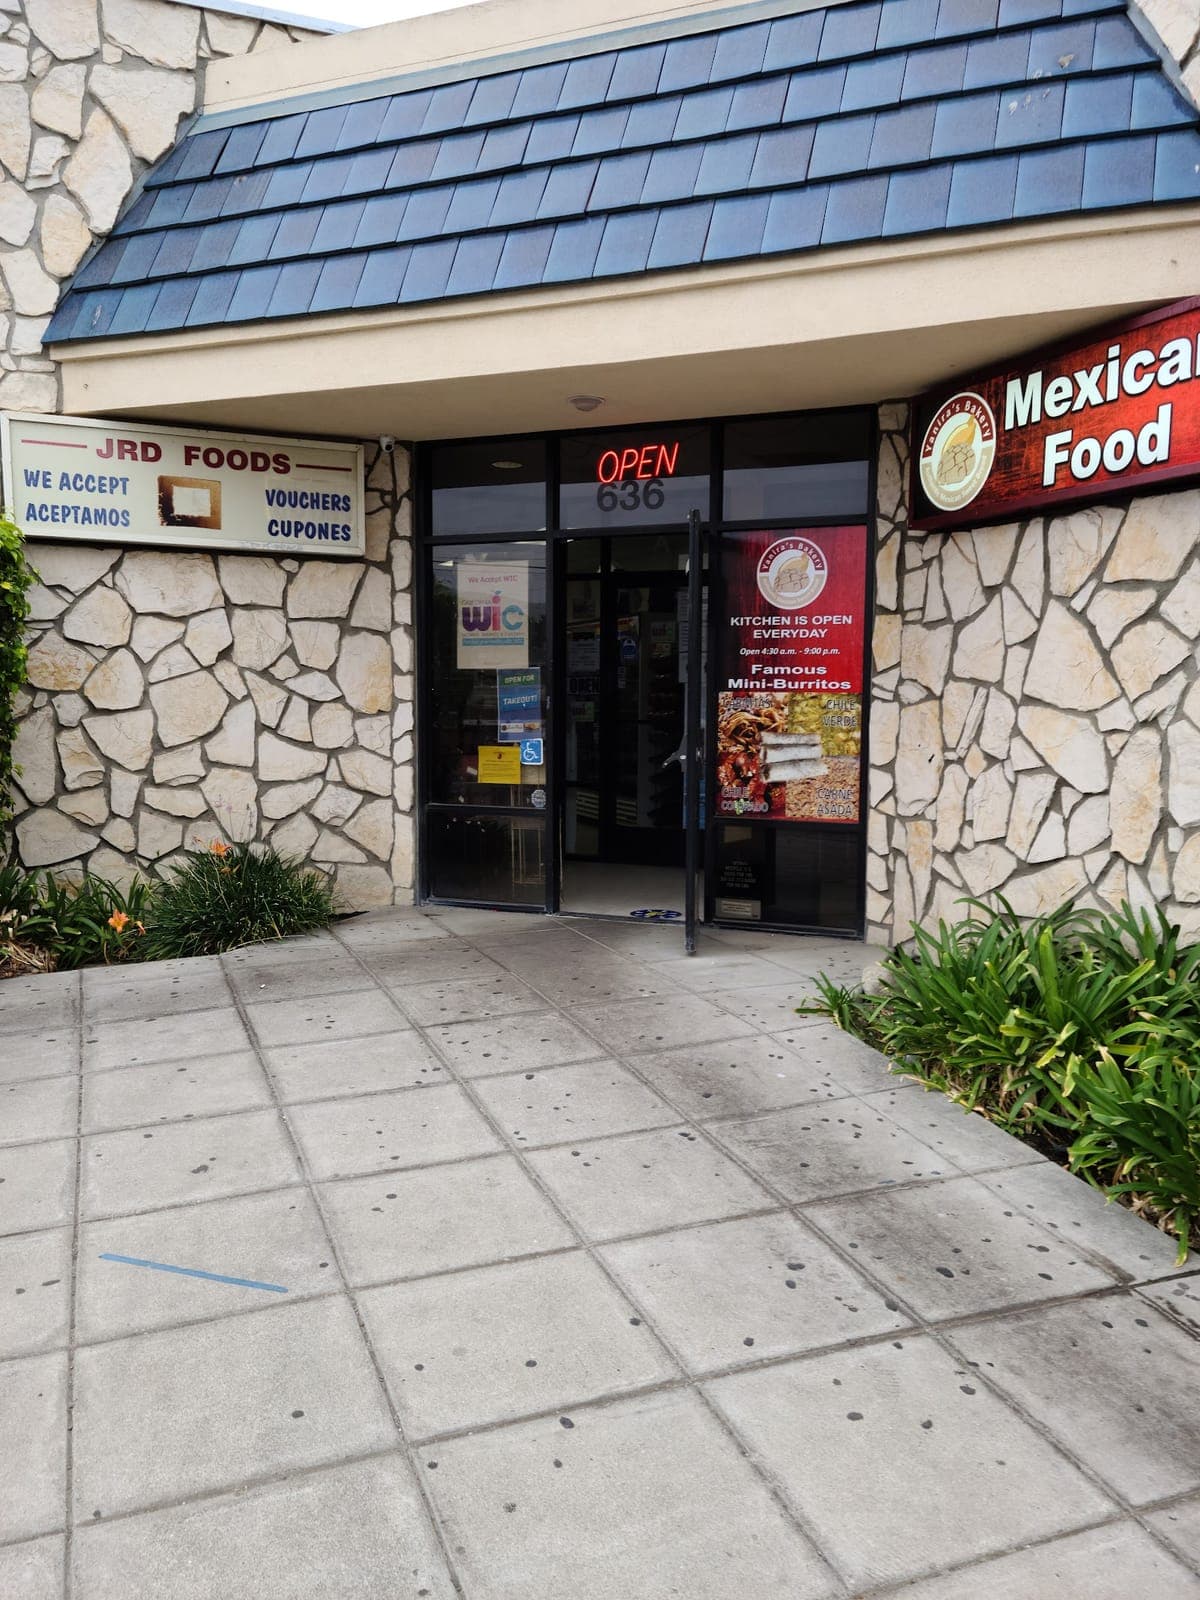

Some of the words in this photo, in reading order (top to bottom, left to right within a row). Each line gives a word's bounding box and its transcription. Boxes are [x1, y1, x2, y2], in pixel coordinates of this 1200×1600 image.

[1004, 333, 1200, 431] Mexica
[925, 402, 961, 453] Yanira's
[964, 400, 991, 438] Bakery
[1043, 402, 1173, 487] Food
[96, 438, 162, 463] JRD
[184, 445, 291, 475] FOODS
[597, 442, 680, 484] OPEN
[23, 469, 52, 489] WE
[58, 471, 130, 496] ACCEPT
[265, 489, 351, 513] VOUCHERS
[596, 478, 665, 512] 636
[25, 503, 131, 527] ACEPTAMOS
[267, 519, 351, 541] CUPONES
[761, 541, 794, 569] Yanira's
[798, 542, 823, 568] Bakery
[480, 576, 501, 584] Accept
[462, 594, 524, 632] wic
[730, 616, 791, 626] KITCHEN
[795, 616, 808, 625] IS
[812, 615, 853, 625] OPEN
[753, 629, 828, 639] EVERYDAY
[739, 648, 760, 656] Open
[822, 648, 841, 656] p.m.
[751, 665, 828, 675] Famous
[504, 675, 522, 684] OPEN
[728, 679, 851, 690] Mini-Burritos
[503, 695, 538, 705] TAKEOUT!
[826, 699, 857, 710] CHILE
[823, 715, 857, 727] VERDE
[721, 787, 750, 798] CHILE
[817, 788, 853, 799] CARNE
[817, 803, 853, 815] ASADA
